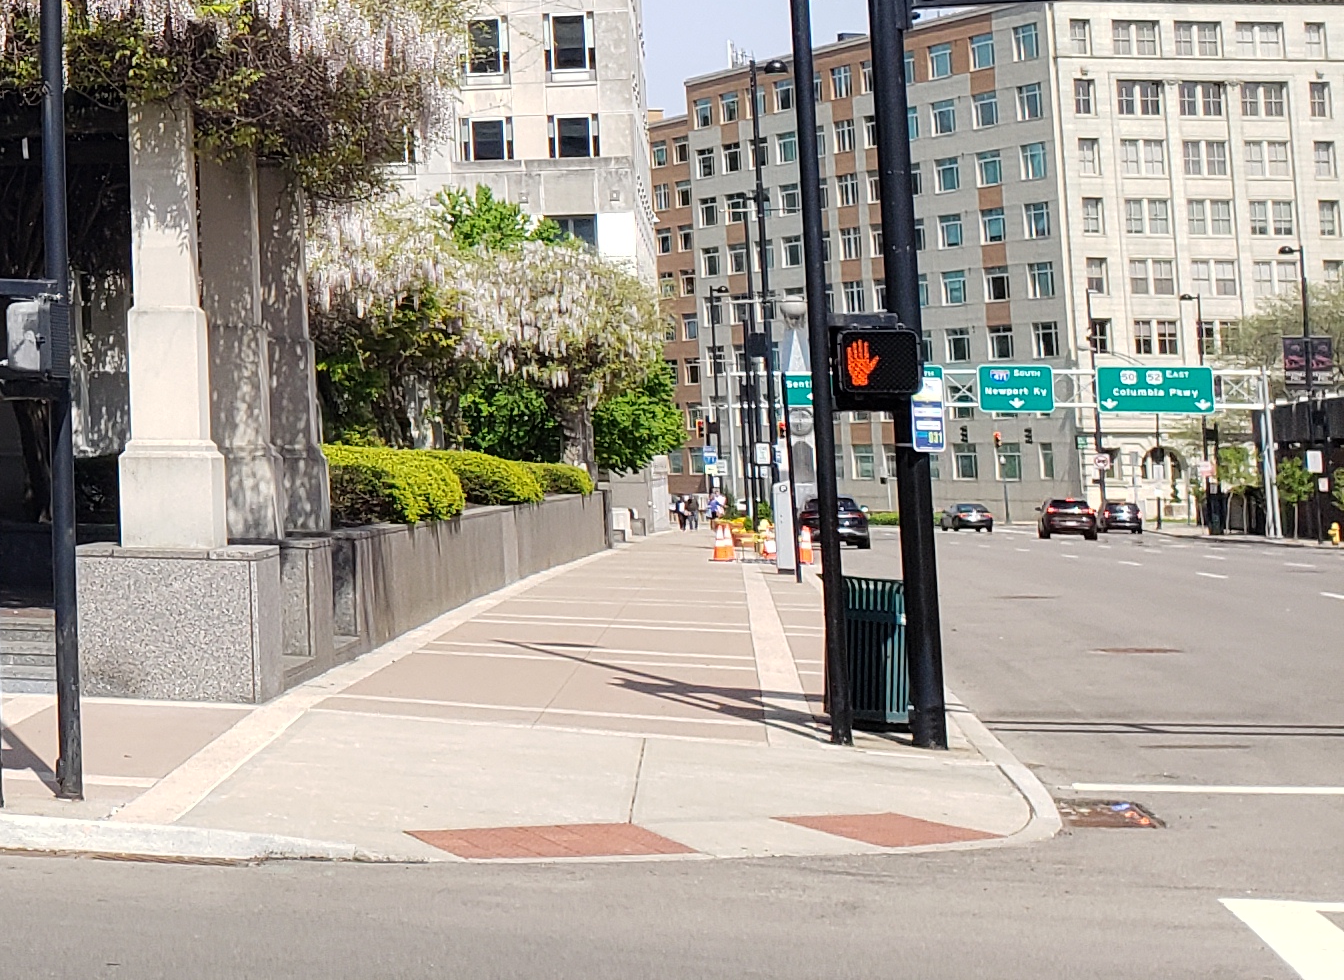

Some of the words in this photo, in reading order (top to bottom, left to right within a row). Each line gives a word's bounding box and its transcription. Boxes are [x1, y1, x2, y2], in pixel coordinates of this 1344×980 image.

[993, 373, 1007, 381] 471
[1122, 373, 1135, 381] 50
[1147, 373, 1160, 381] 52
[984, 386, 1029, 396] Newport
[1033, 386, 1047, 397] Ky
[1112, 387, 1165, 397] Columbia
[1169, 388, 1199, 398] Pkwy
